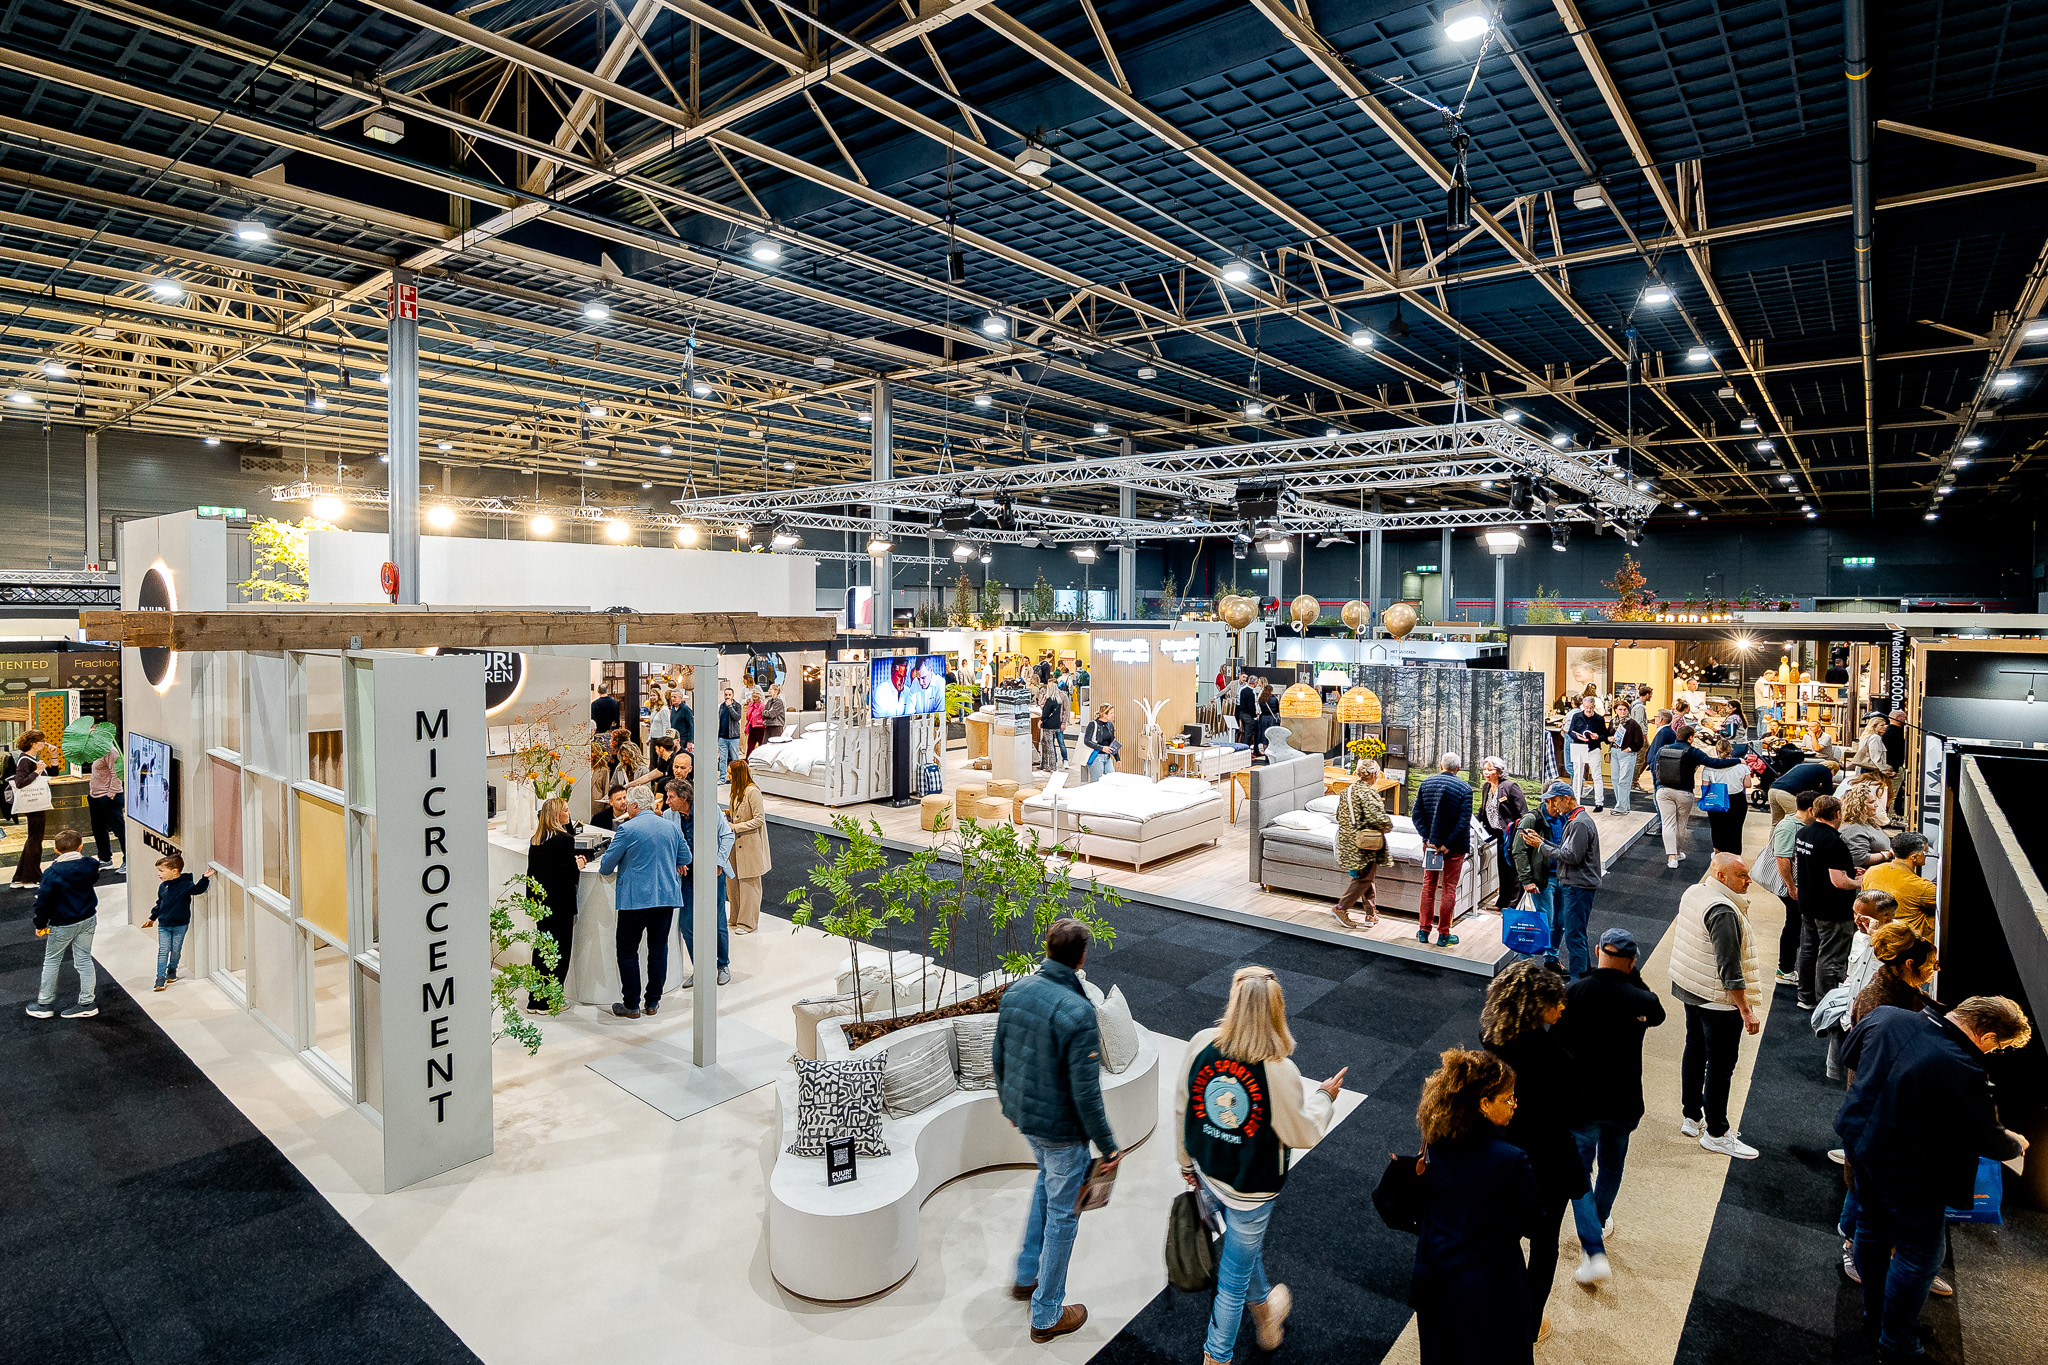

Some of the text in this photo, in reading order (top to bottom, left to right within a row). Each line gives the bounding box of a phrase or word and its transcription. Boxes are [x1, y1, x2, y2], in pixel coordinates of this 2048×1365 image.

[1892, 630, 1905, 666] Welkom
[485, 670, 513, 682] REN
[415, 708, 455, 1124] MICROCEMENT
[1192, 1065, 1214, 1118] PEANUTS
[1215, 1060, 1262, 1101] SPORTING
